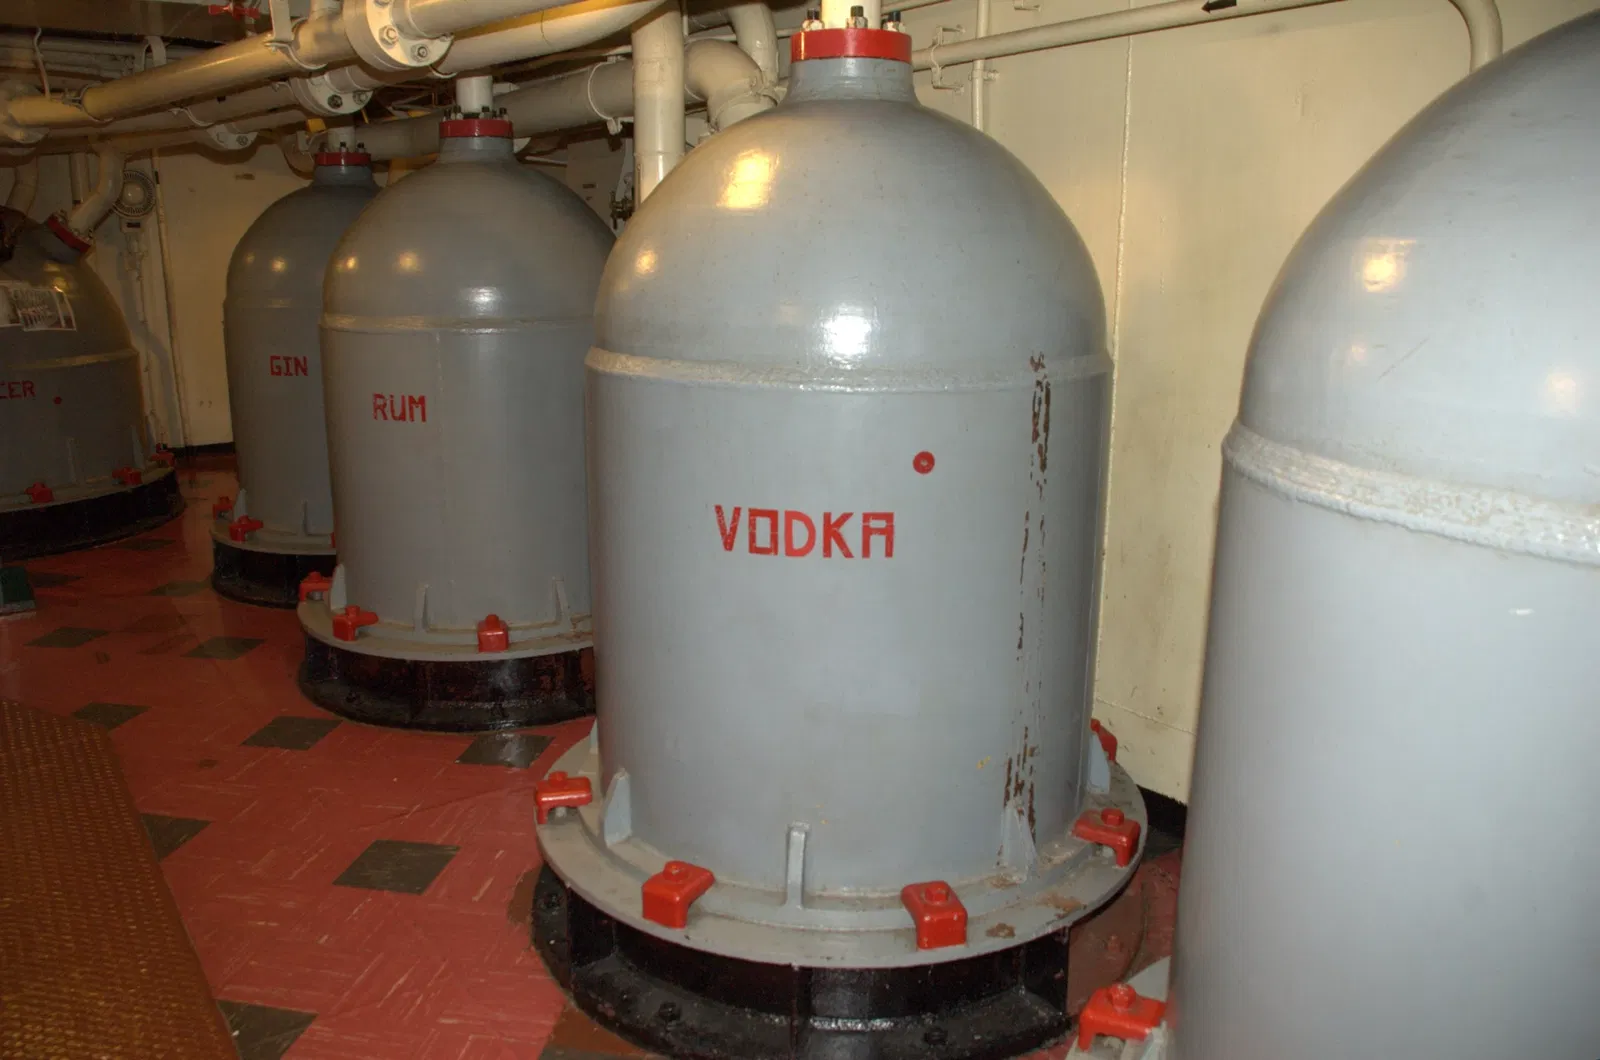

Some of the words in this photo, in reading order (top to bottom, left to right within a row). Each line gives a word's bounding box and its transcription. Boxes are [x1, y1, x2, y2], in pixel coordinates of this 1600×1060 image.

[269, 355, 308, 376] GIN
[373, 393, 427, 422] RUM
[714, 505, 895, 559] VODKA
